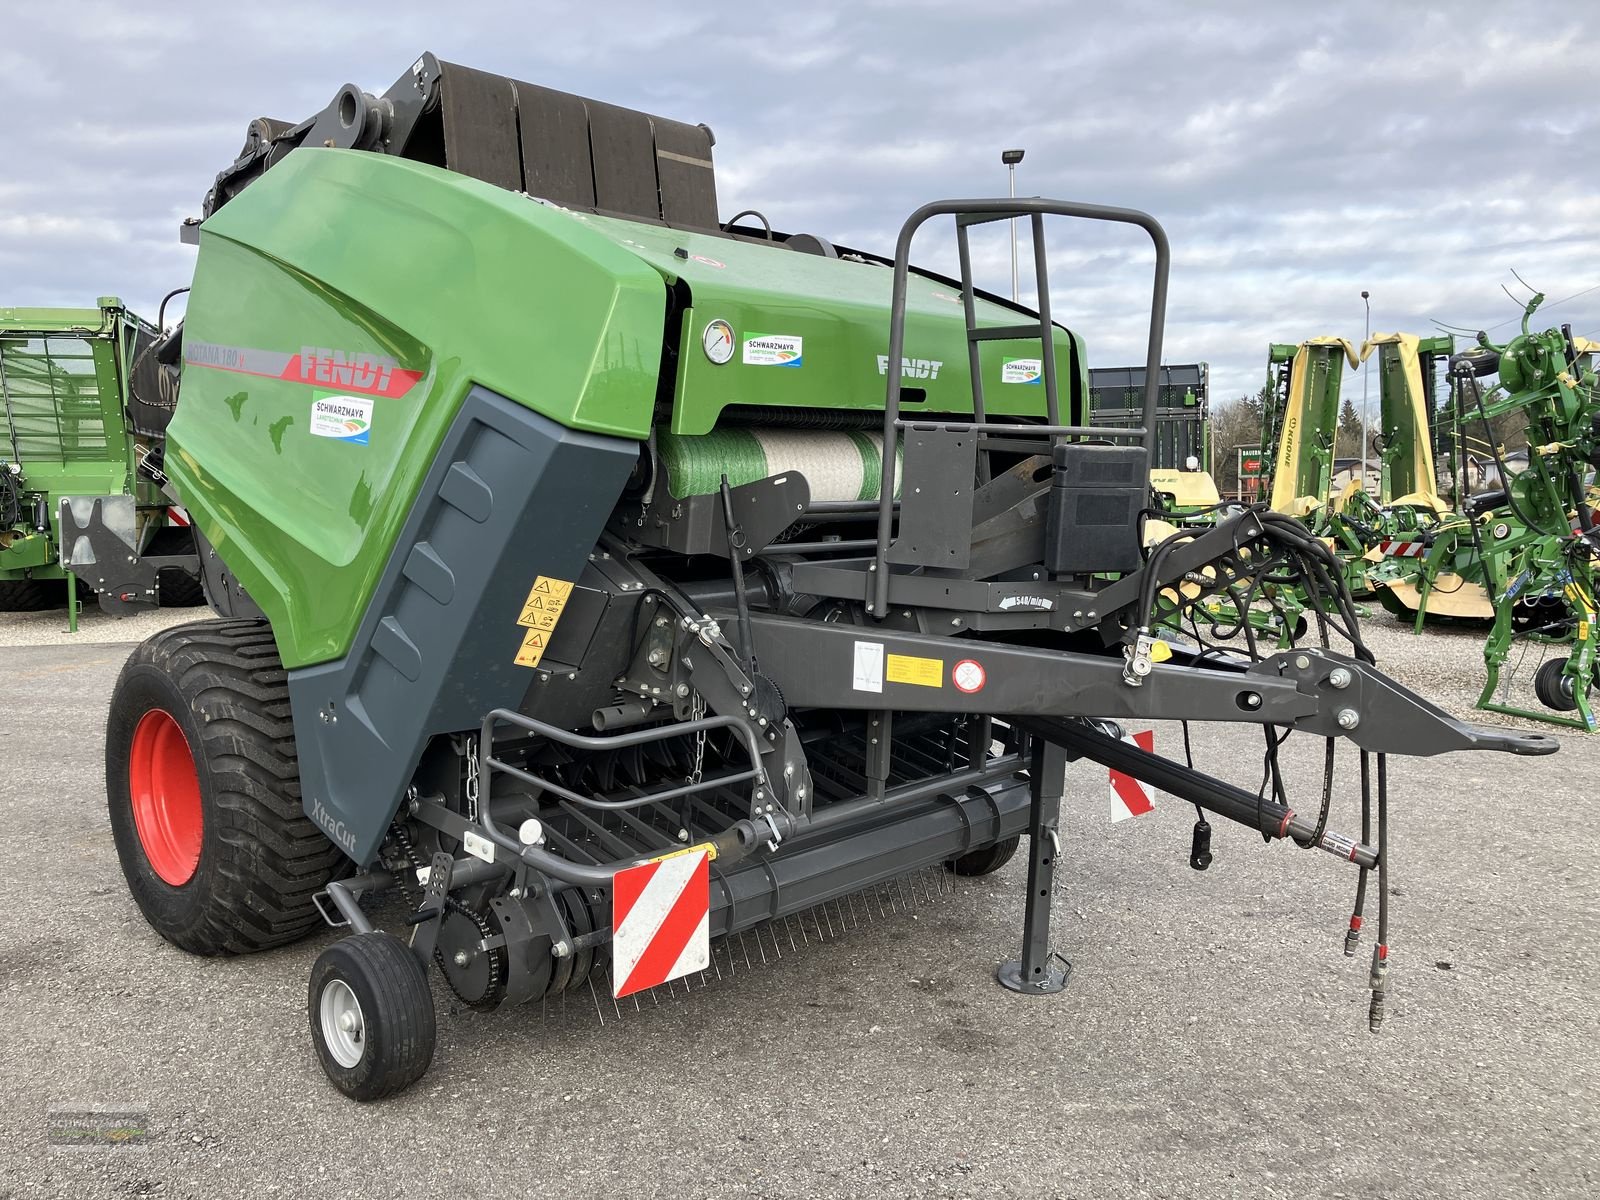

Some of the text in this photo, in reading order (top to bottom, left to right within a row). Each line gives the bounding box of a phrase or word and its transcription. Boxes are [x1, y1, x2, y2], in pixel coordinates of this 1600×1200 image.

[186, 344, 220, 364] ROTANA
[223, 348, 237, 367] 180
[749, 341, 794, 350] SCHWARZMAYR
[301, 346, 399, 391] FENDT
[877, 354, 943, 379] FNDT
[316, 402, 364, 418] SCHWARZMAYR
[1285, 429, 1294, 468] KRONE
[1016, 596, 1042, 607] 540/min
[312, 798, 356, 853] XtraCut
